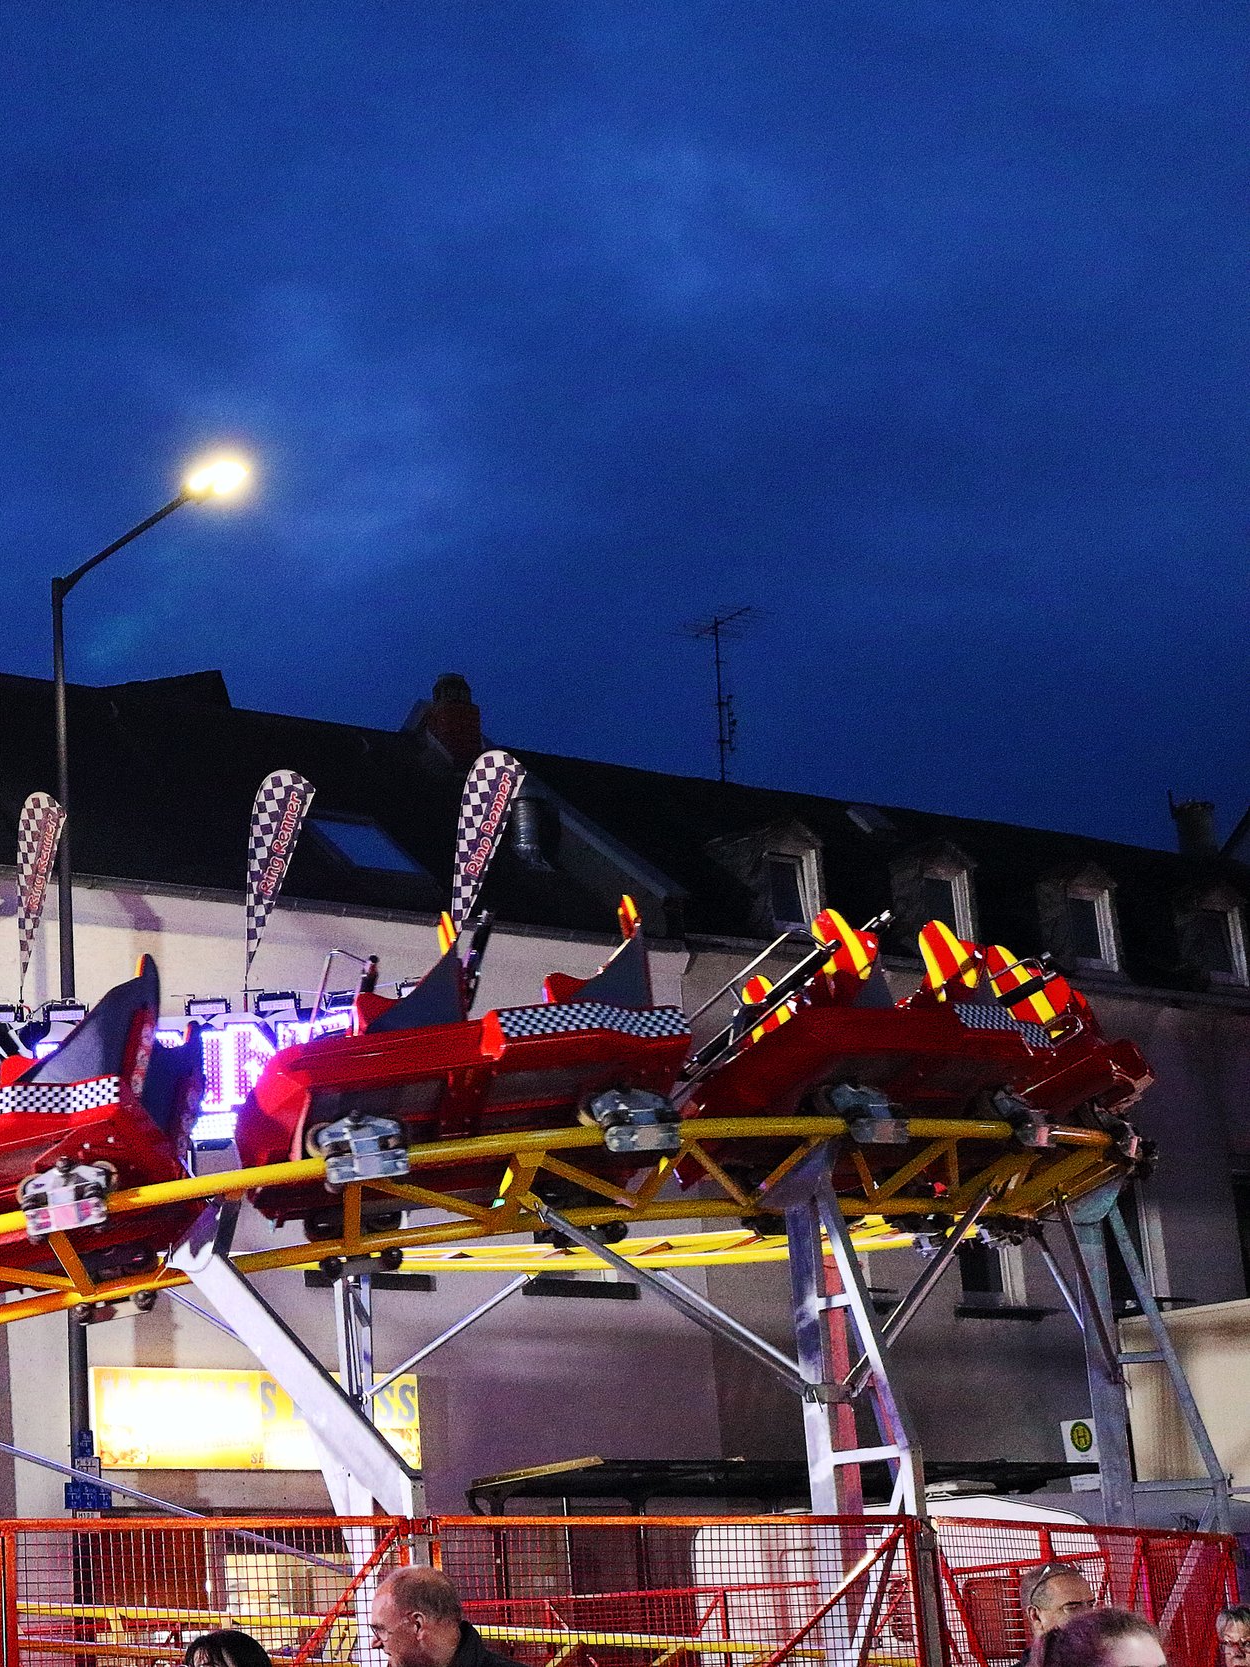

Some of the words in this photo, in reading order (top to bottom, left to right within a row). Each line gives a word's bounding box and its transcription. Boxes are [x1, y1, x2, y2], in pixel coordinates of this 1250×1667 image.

[272, 791, 301, 855] Renner
[481, 772, 511, 837] Renner
[36, 813, 57, 873] Renner
[259, 856, 286, 895] Ring
